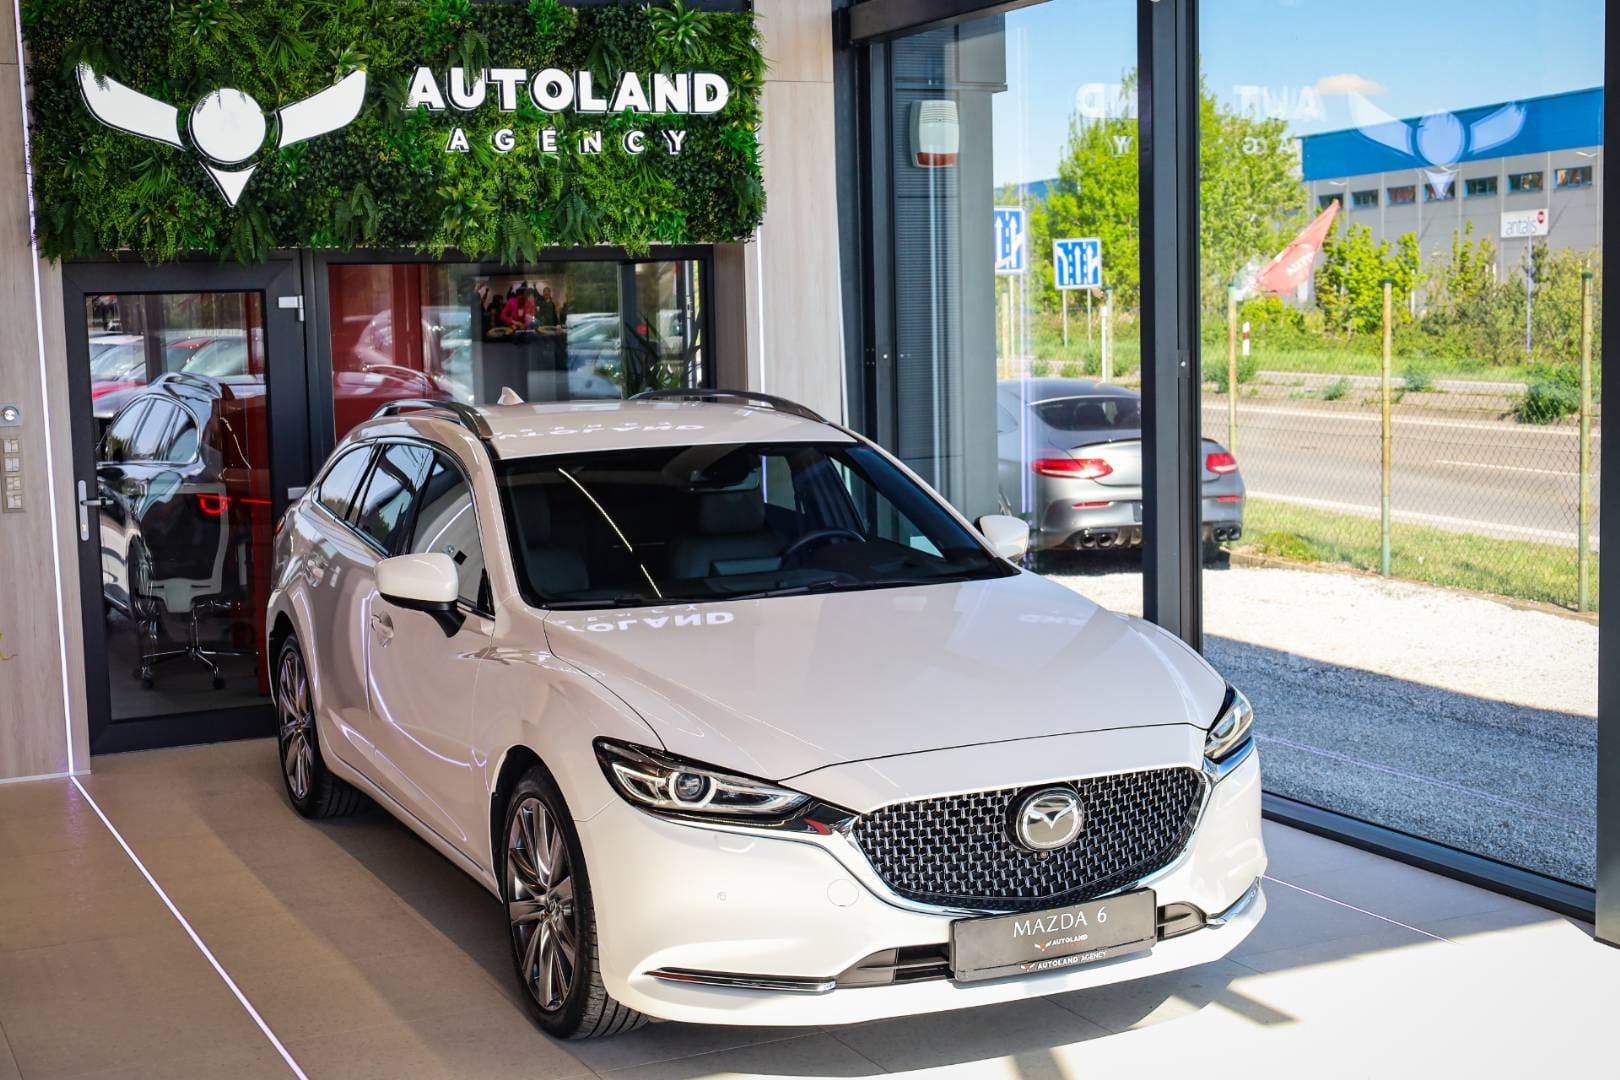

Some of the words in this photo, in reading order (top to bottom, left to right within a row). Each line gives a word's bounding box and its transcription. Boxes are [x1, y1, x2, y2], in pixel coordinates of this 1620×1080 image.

[401, 66, 729, 114] AUTOLAND
[445, 127, 687, 155] AGENCY
[1013, 911, 1088, 938] MAZDA
[1097, 907, 1107, 924] 6
[1052, 934, 1088, 945] AUTOLAND
[1038, 957, 1078, 970] AUTOLAND
[1081, 951, 1107, 962] AGENCY
